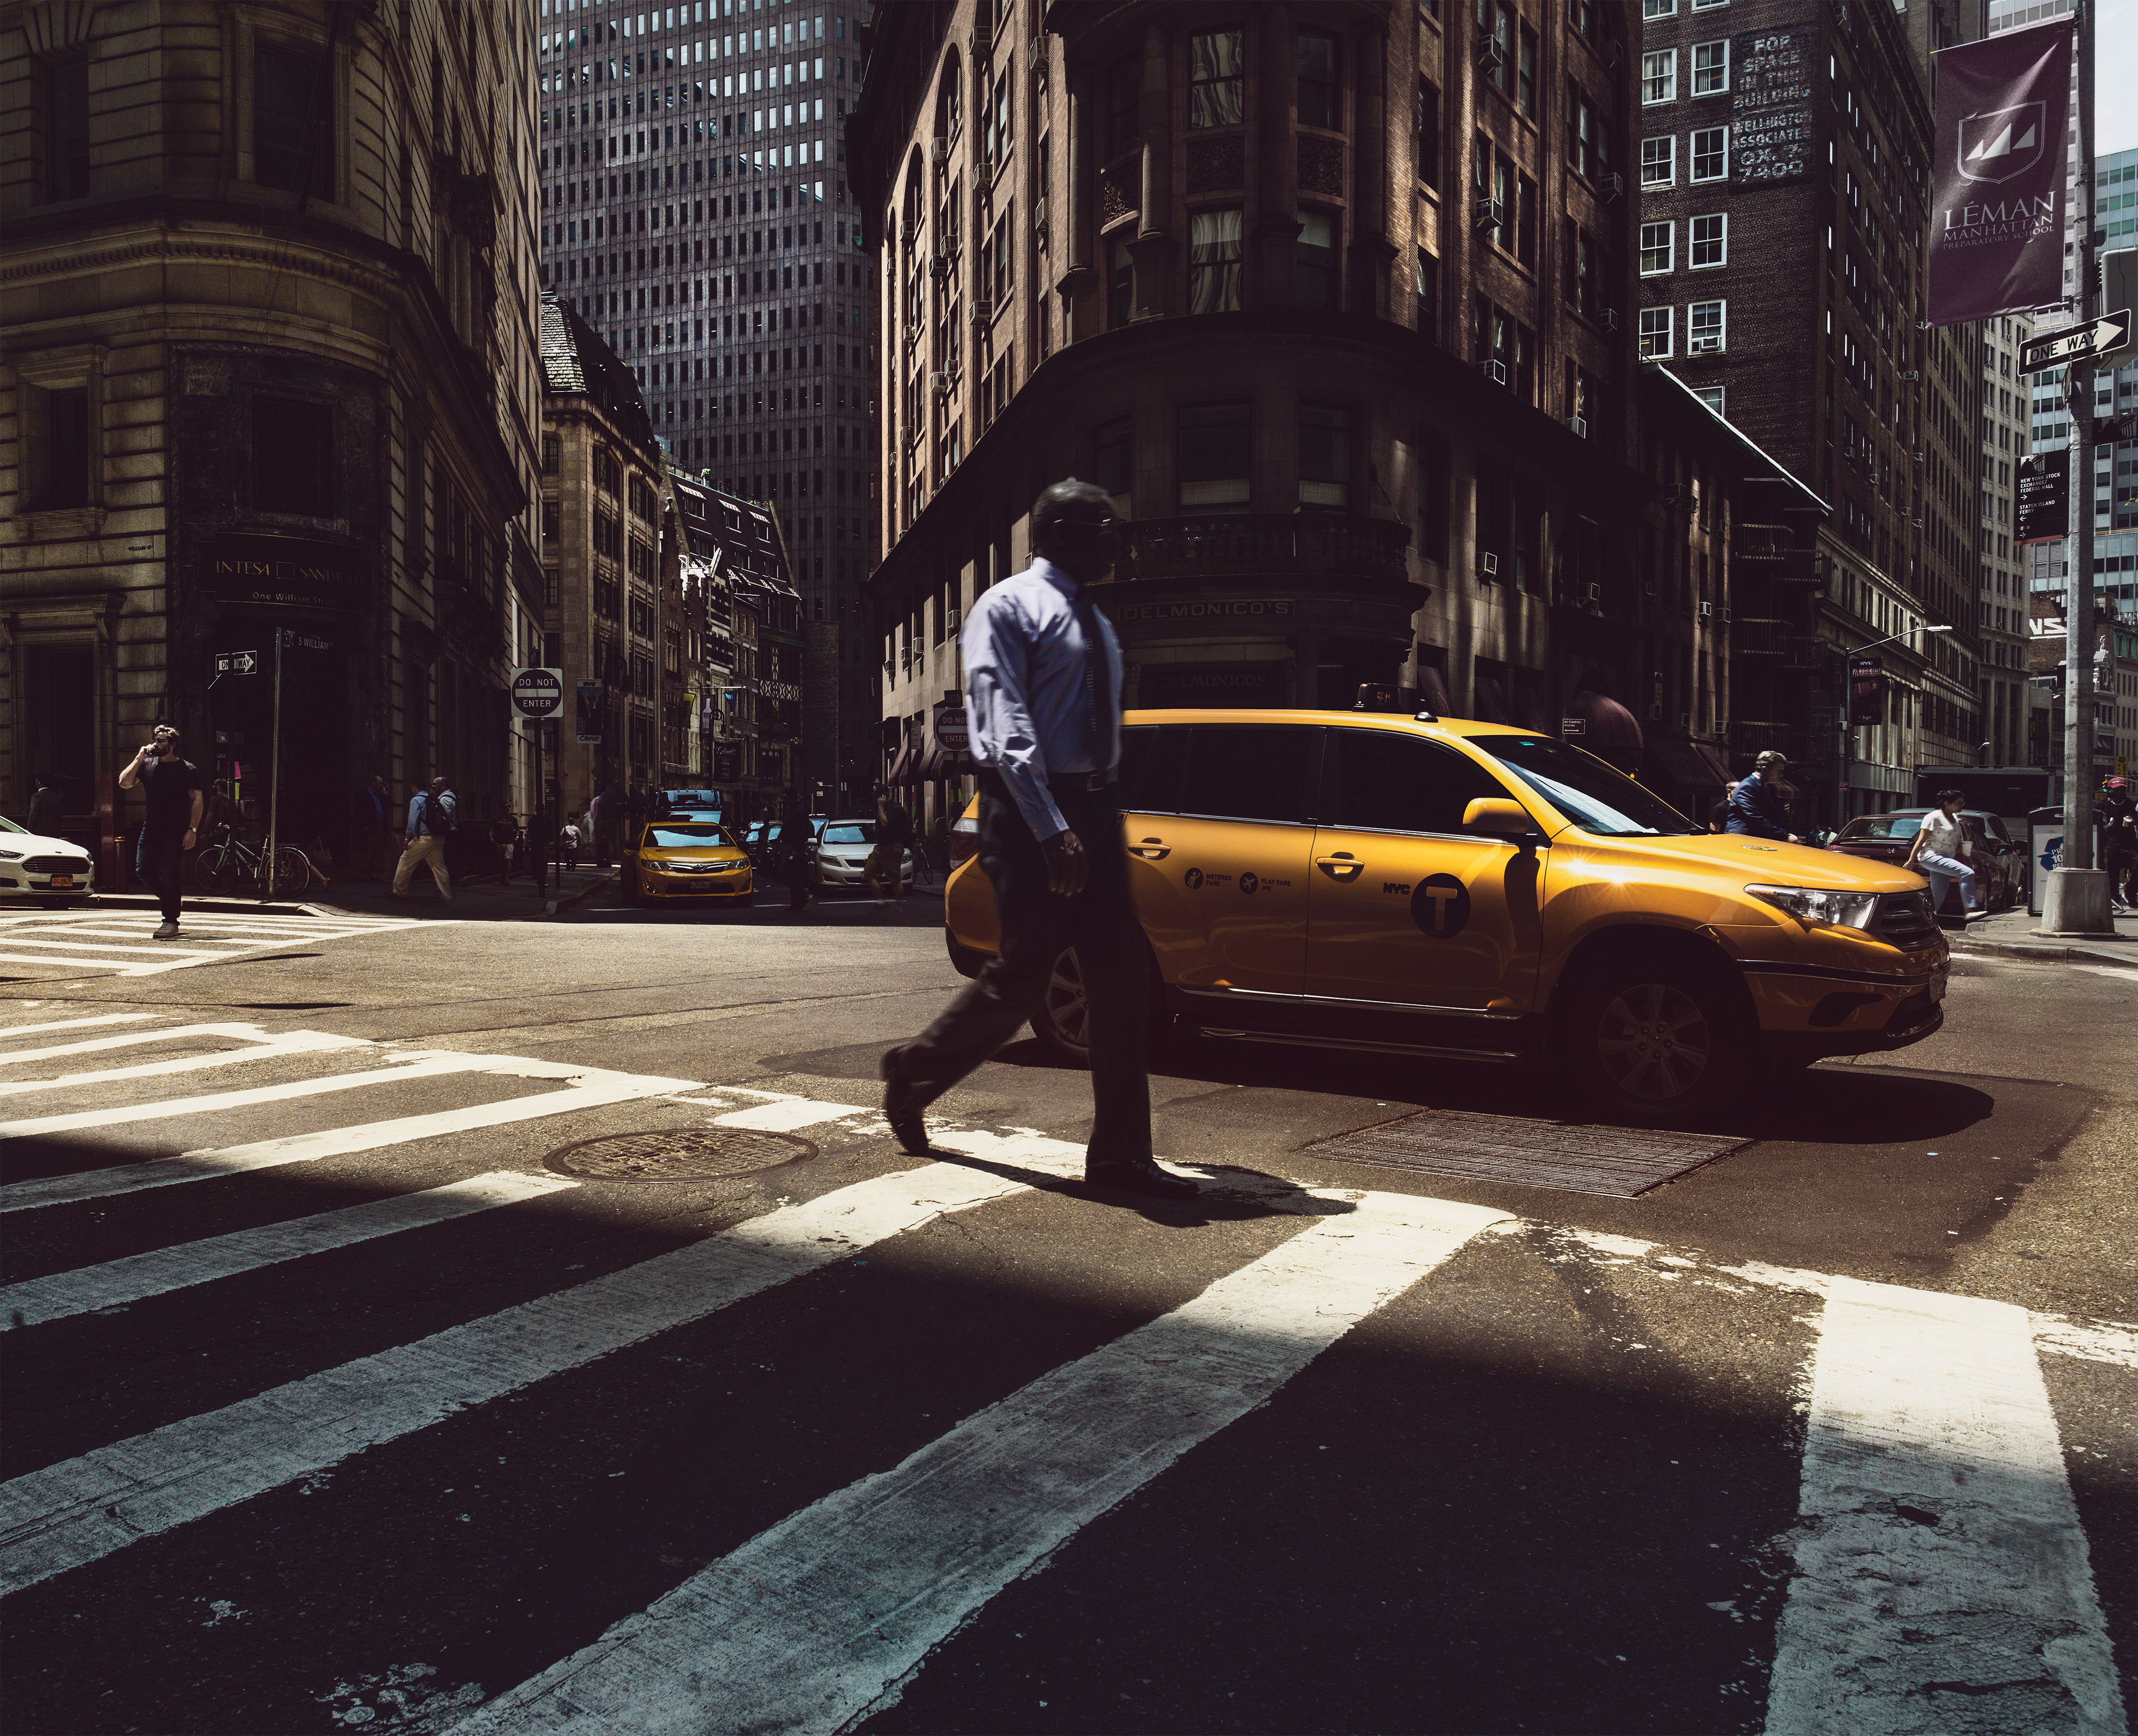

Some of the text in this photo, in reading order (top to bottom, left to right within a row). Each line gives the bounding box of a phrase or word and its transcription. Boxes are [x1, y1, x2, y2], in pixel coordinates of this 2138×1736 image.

[1943, 191, 2056, 230] LÉMAN
[1943, 214, 2054, 242] MANHATTAN
[1943, 226, 2054, 250] PREPARATORY SCHOOL
[2031, 330, 2098, 362] ONE WAY
[2020, 479, 2047, 488] EXCHANGE/
[216, 561, 363, 587] INTESA SANPAOLO
[253, 592, 338, 606] One William Street
[1124, 602, 1289, 621] DELMONICO'S
[298, 637, 303, 646] S
[304, 638, 329, 650] WILLIAM
[238, 658, 251, 668] WAY
[537, 678, 554, 686] NOT
[1159, 673, 1266, 688] DELMONICOS
[523, 700, 551, 708] ENTER
[1383, 882, 1411, 895] NYC
[1426, 886, 1458, 930] T
